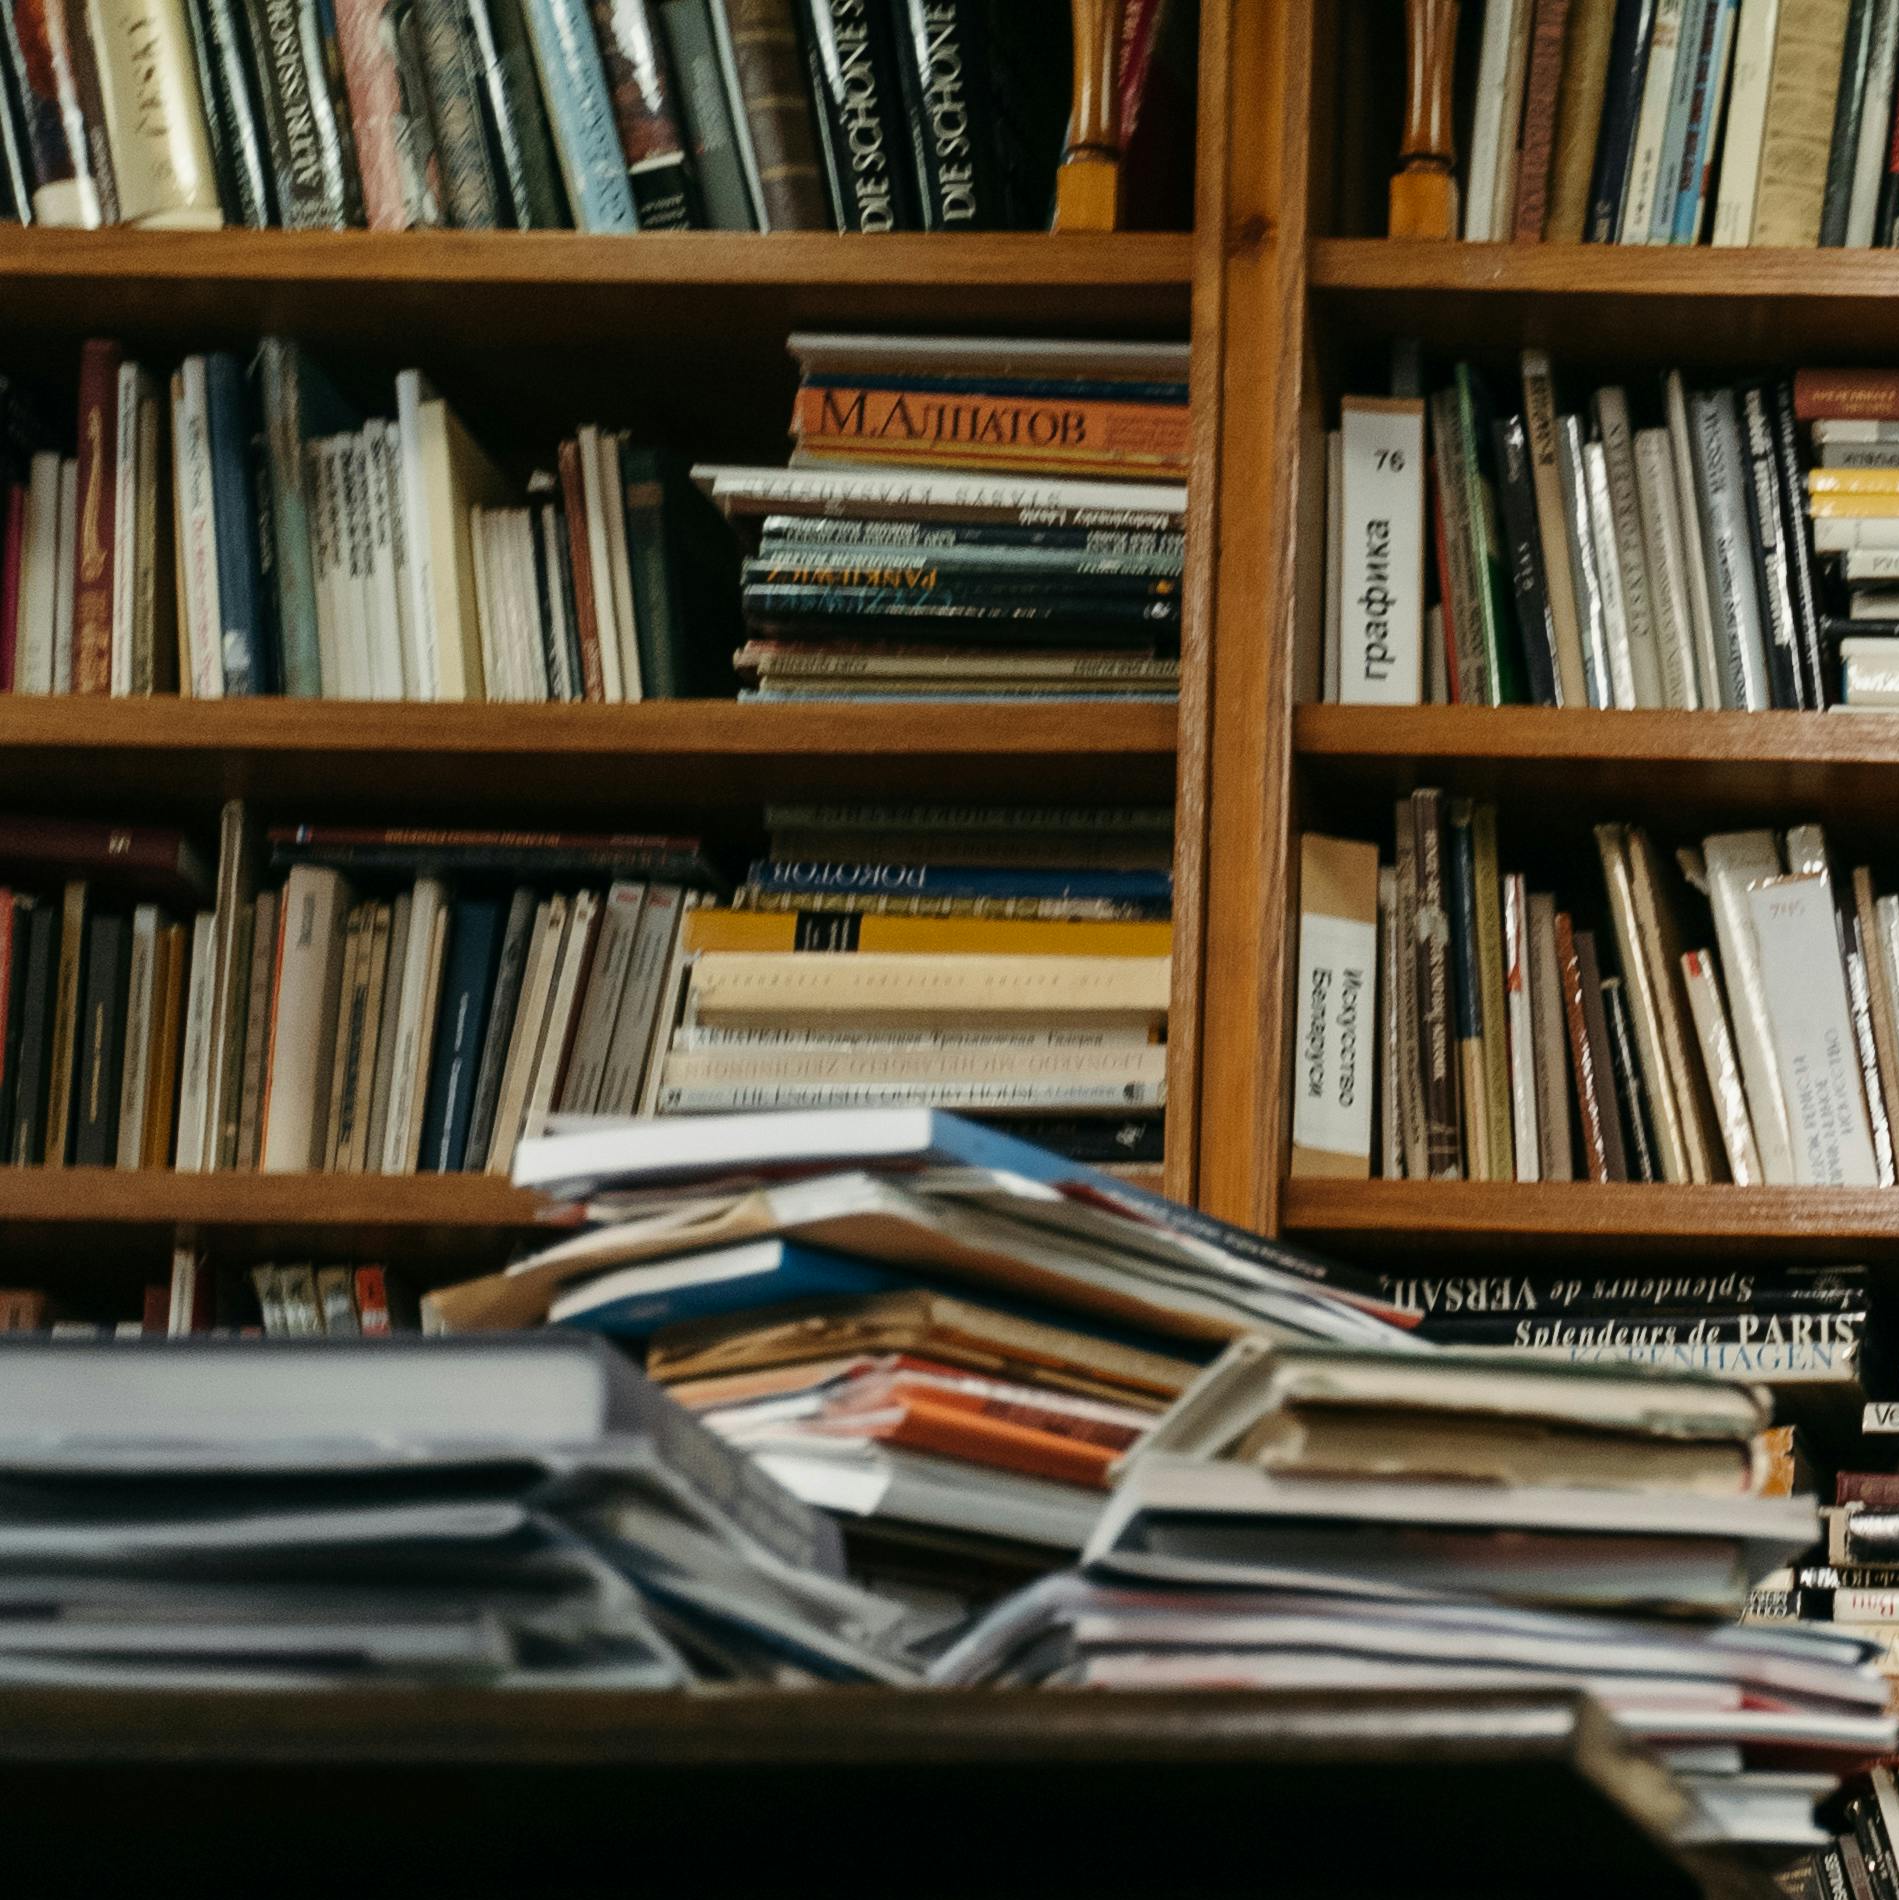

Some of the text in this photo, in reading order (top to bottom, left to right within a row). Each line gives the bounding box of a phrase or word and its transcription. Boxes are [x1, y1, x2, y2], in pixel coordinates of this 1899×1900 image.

[853, 169, 894, 233] DIE
[938, 164, 976, 223] DIE
[1373, 448, 1405, 474] 76
[1363, 516, 1396, 682] графика
[1550, 1280, 1582, 1304] de
[1593, 1276, 1755, 1303] Splendeurs
[1513, 1312, 1858, 1349] Splendeurs de PARIS
